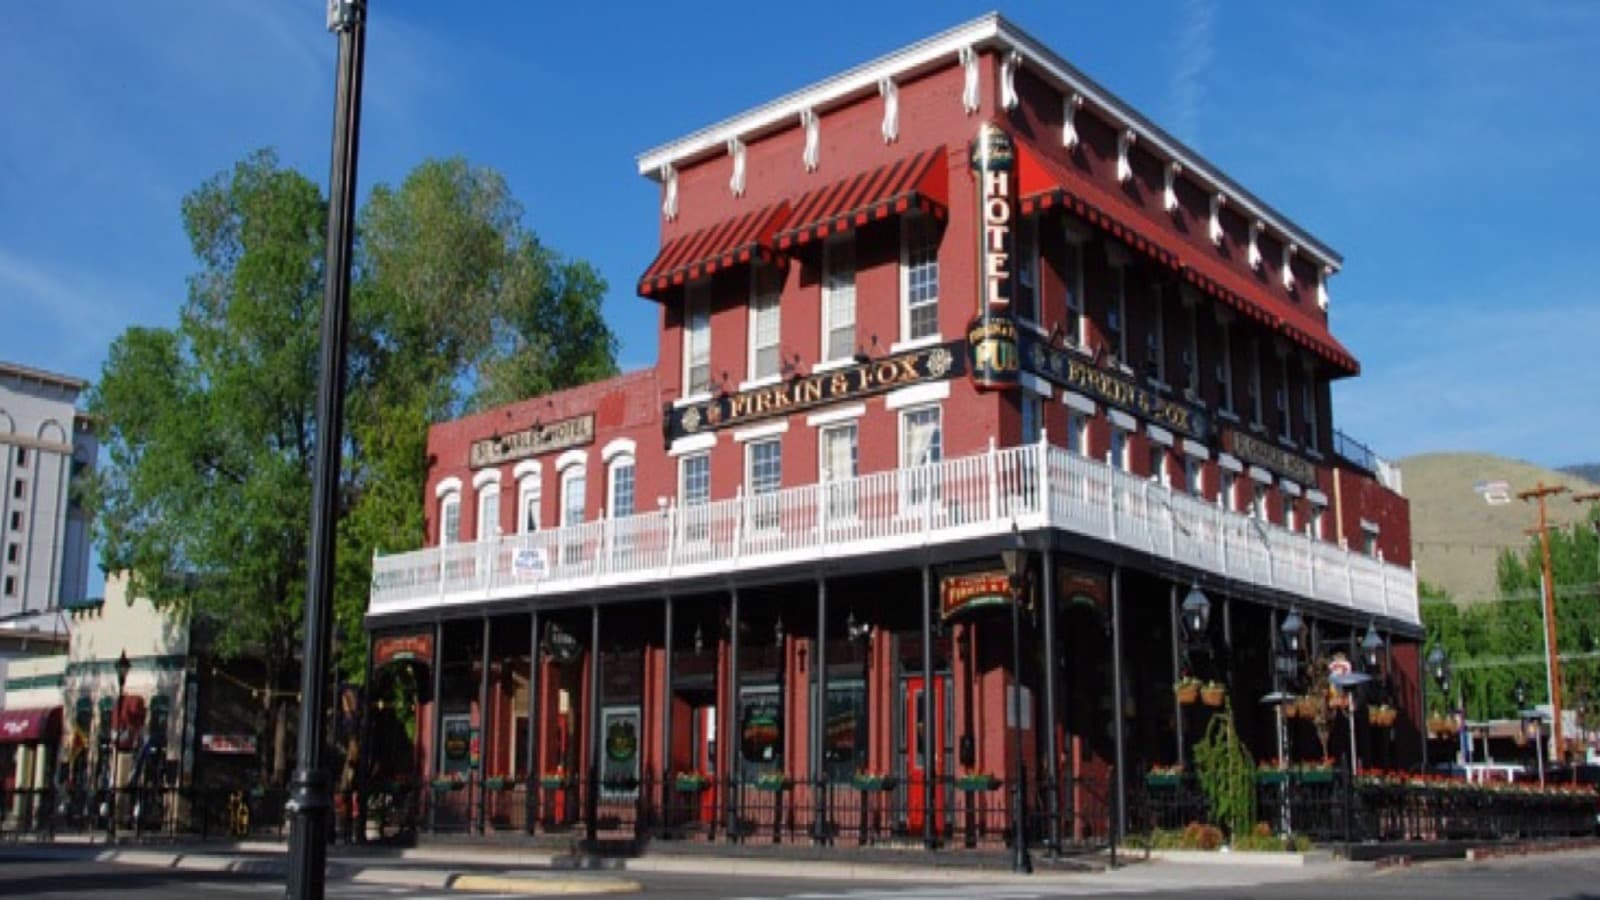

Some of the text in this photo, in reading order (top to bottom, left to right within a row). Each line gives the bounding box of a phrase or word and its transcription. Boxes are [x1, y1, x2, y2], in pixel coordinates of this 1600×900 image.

[985, 170, 1011, 305] HOTEL
[730, 355, 921, 417] FIRKIN & FOX
